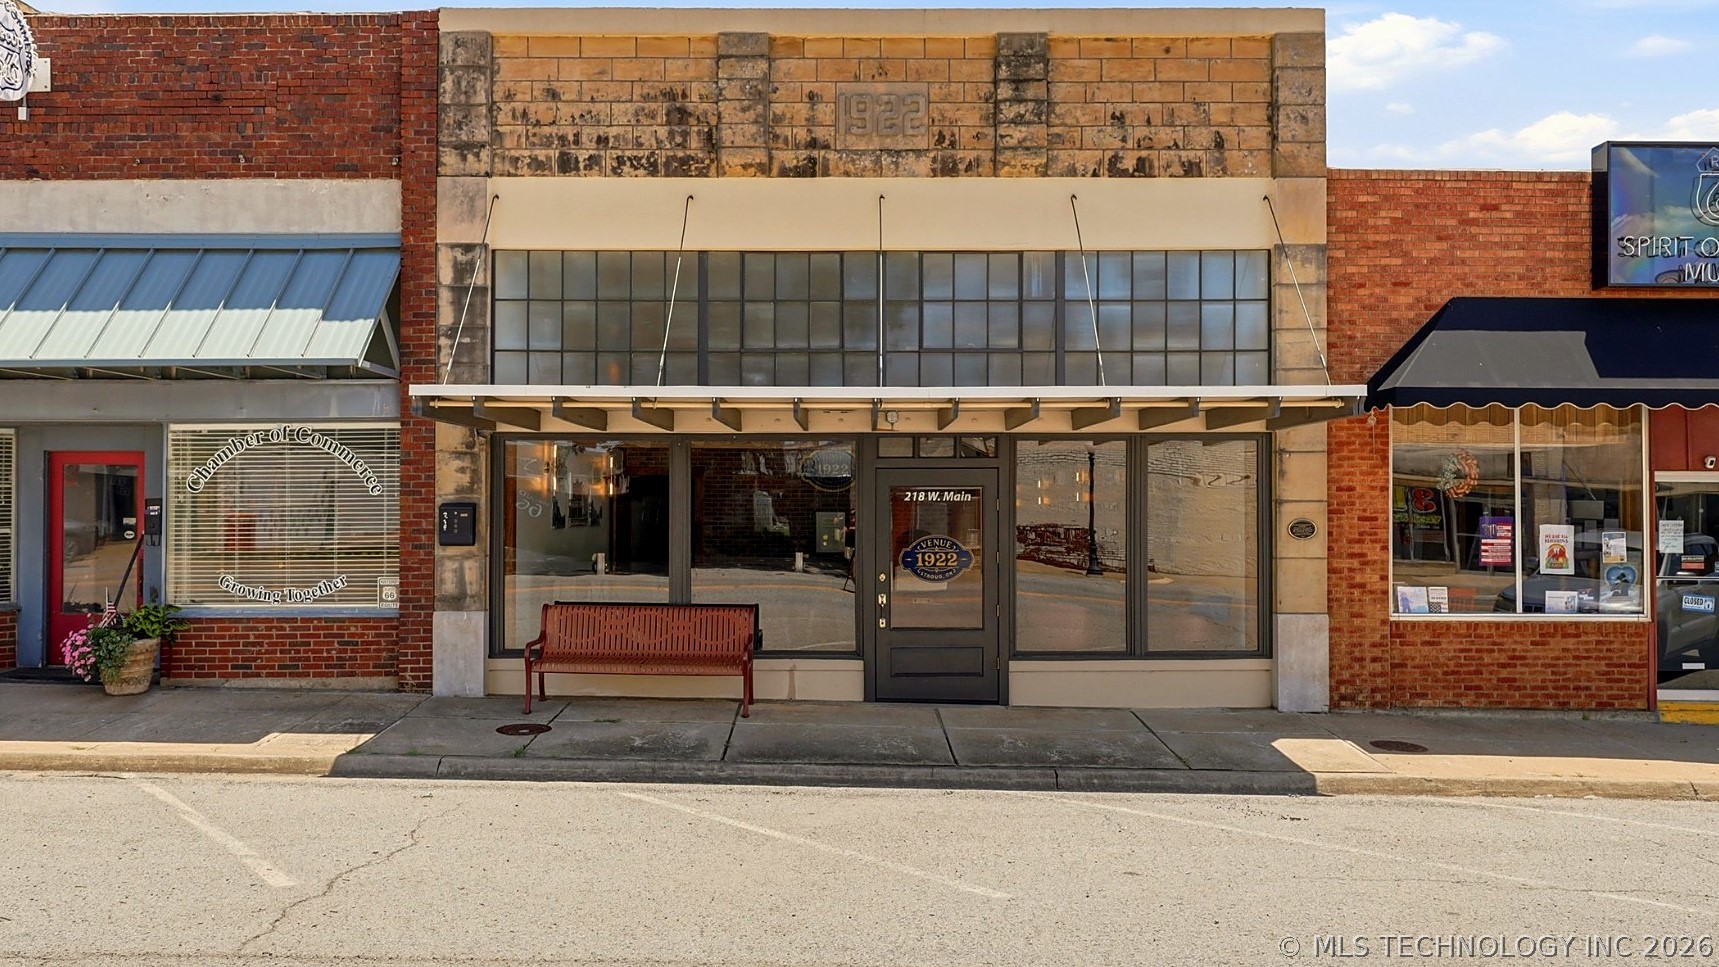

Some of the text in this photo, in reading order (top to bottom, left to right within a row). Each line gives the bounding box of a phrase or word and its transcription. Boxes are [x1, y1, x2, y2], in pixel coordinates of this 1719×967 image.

[837, 92, 926, 136] 1922
[1623, 235, 1695, 257] SPIRIT
[186, 424, 383, 495] Chamber of Commerce
[904, 491, 972, 502] 218 W. Main
[920, 538, 953, 549] VENUE
[915, 552, 958, 568] 1922
[218, 574, 347, 606] Growing Together
[1684, 597, 1704, 606] CLOSED
